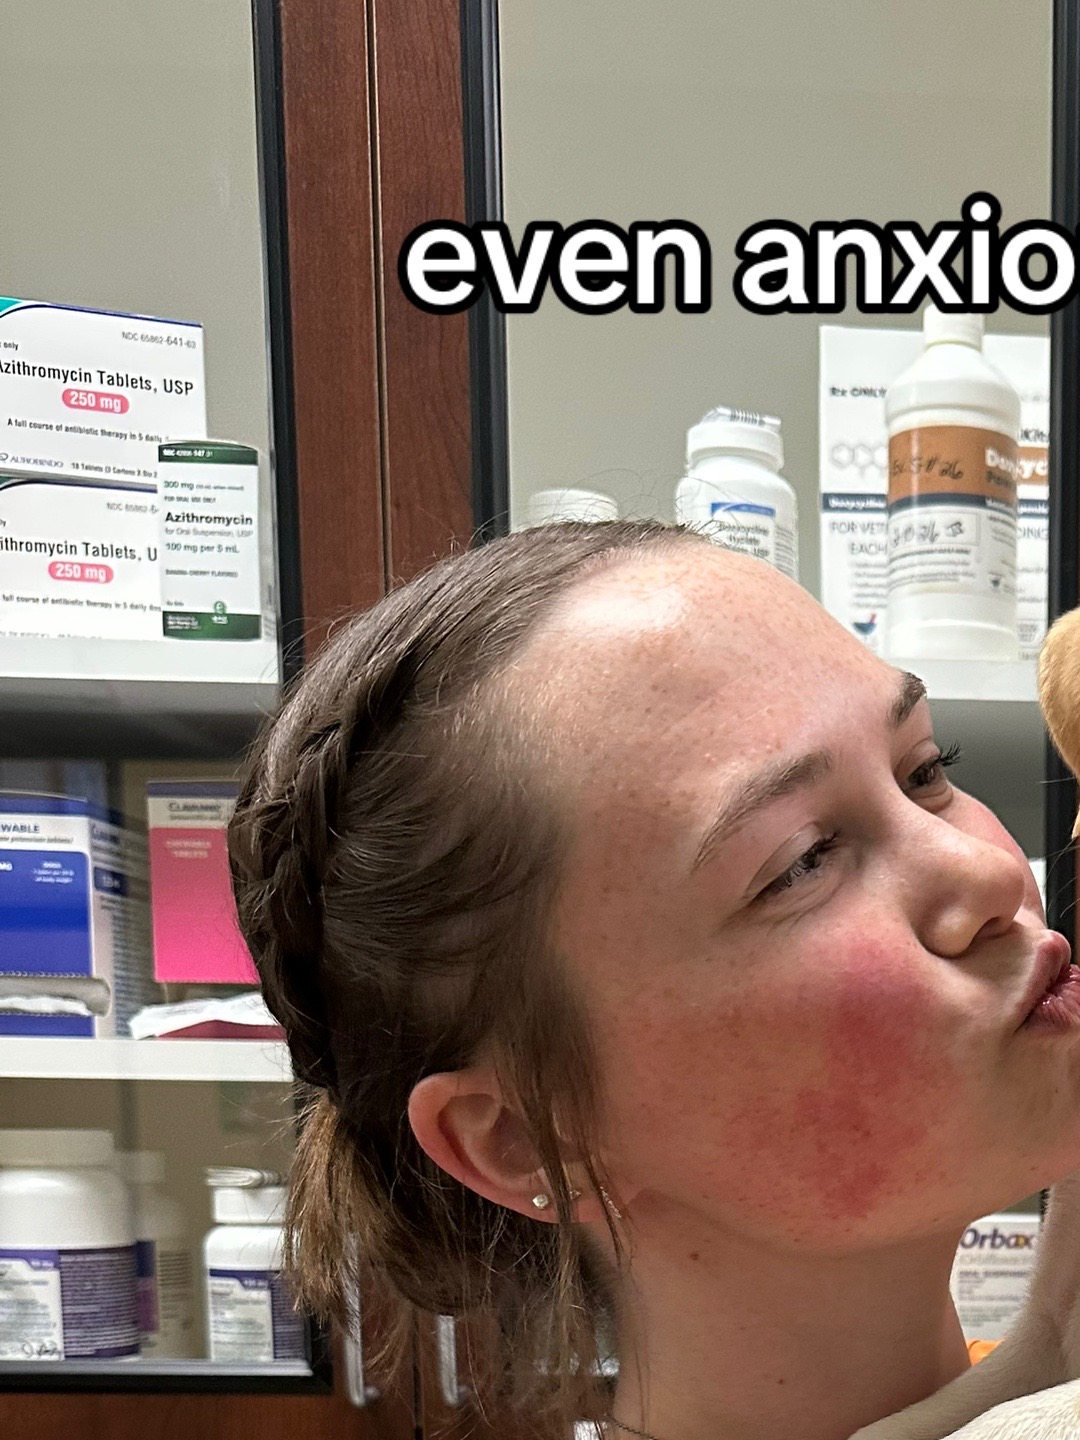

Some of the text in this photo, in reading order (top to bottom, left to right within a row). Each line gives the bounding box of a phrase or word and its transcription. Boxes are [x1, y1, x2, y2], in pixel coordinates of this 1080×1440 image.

[97, 370, 158, 393] Tablets,
[163, 378, 194, 395] USP
[70, 391, 122, 413] 250 mg
[7, 418, 13, 426] A
[29, 421, 54, 431] course
[100, 428, 128, 440] therapy
[165, 512, 253, 526] Azithromycin
[82, 542, 142, 561] Tablets,
[56, 563, 107, 583] 250 mg
